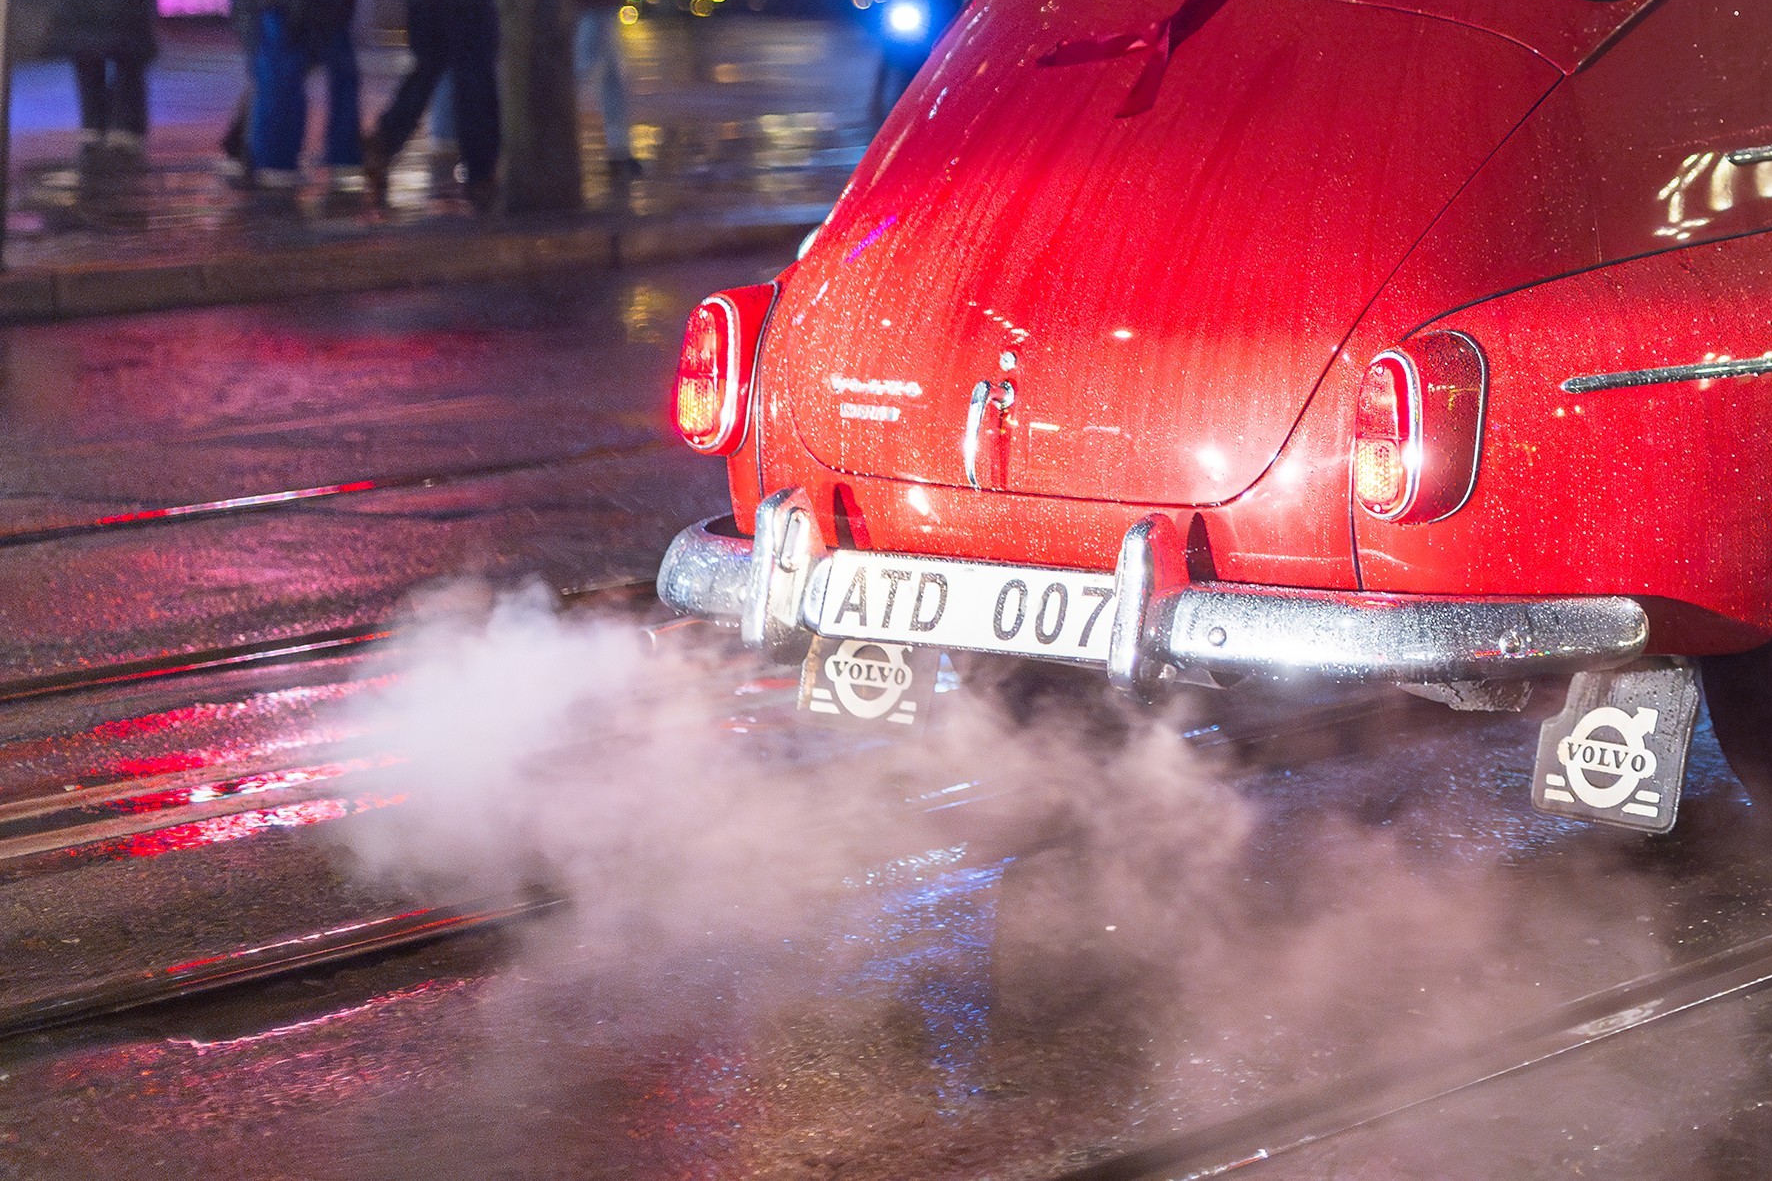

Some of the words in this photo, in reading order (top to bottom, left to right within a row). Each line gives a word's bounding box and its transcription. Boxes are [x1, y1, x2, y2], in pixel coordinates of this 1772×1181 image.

[833, 566, 949, 633] ATD
[992, 578, 1116, 649] 007
[832, 659, 907, 686] VOLVO
[1567, 742, 1646, 772] VOLVO
